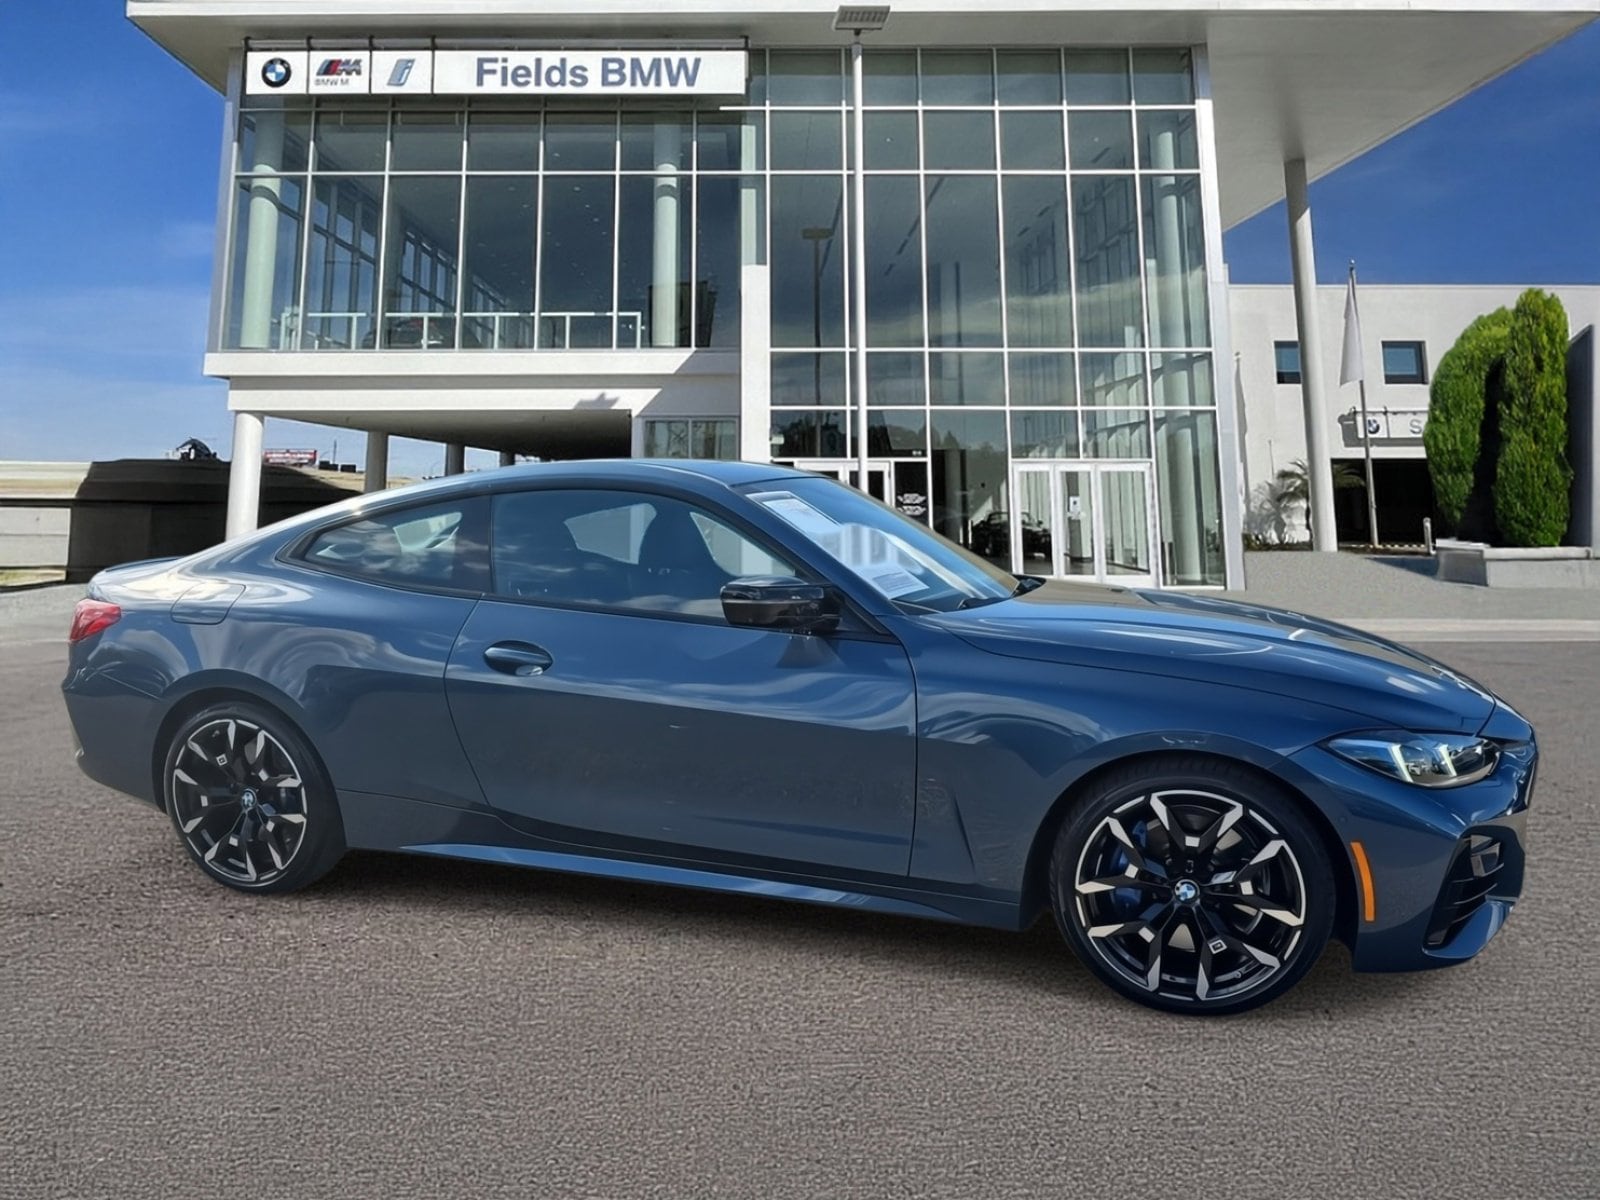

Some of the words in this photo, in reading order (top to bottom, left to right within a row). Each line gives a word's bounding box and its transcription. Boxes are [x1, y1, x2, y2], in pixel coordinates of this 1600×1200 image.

[476, 57, 589, 87] Fields
[600, 57, 701, 87] BMW
[1409, 418, 1423, 435] S
